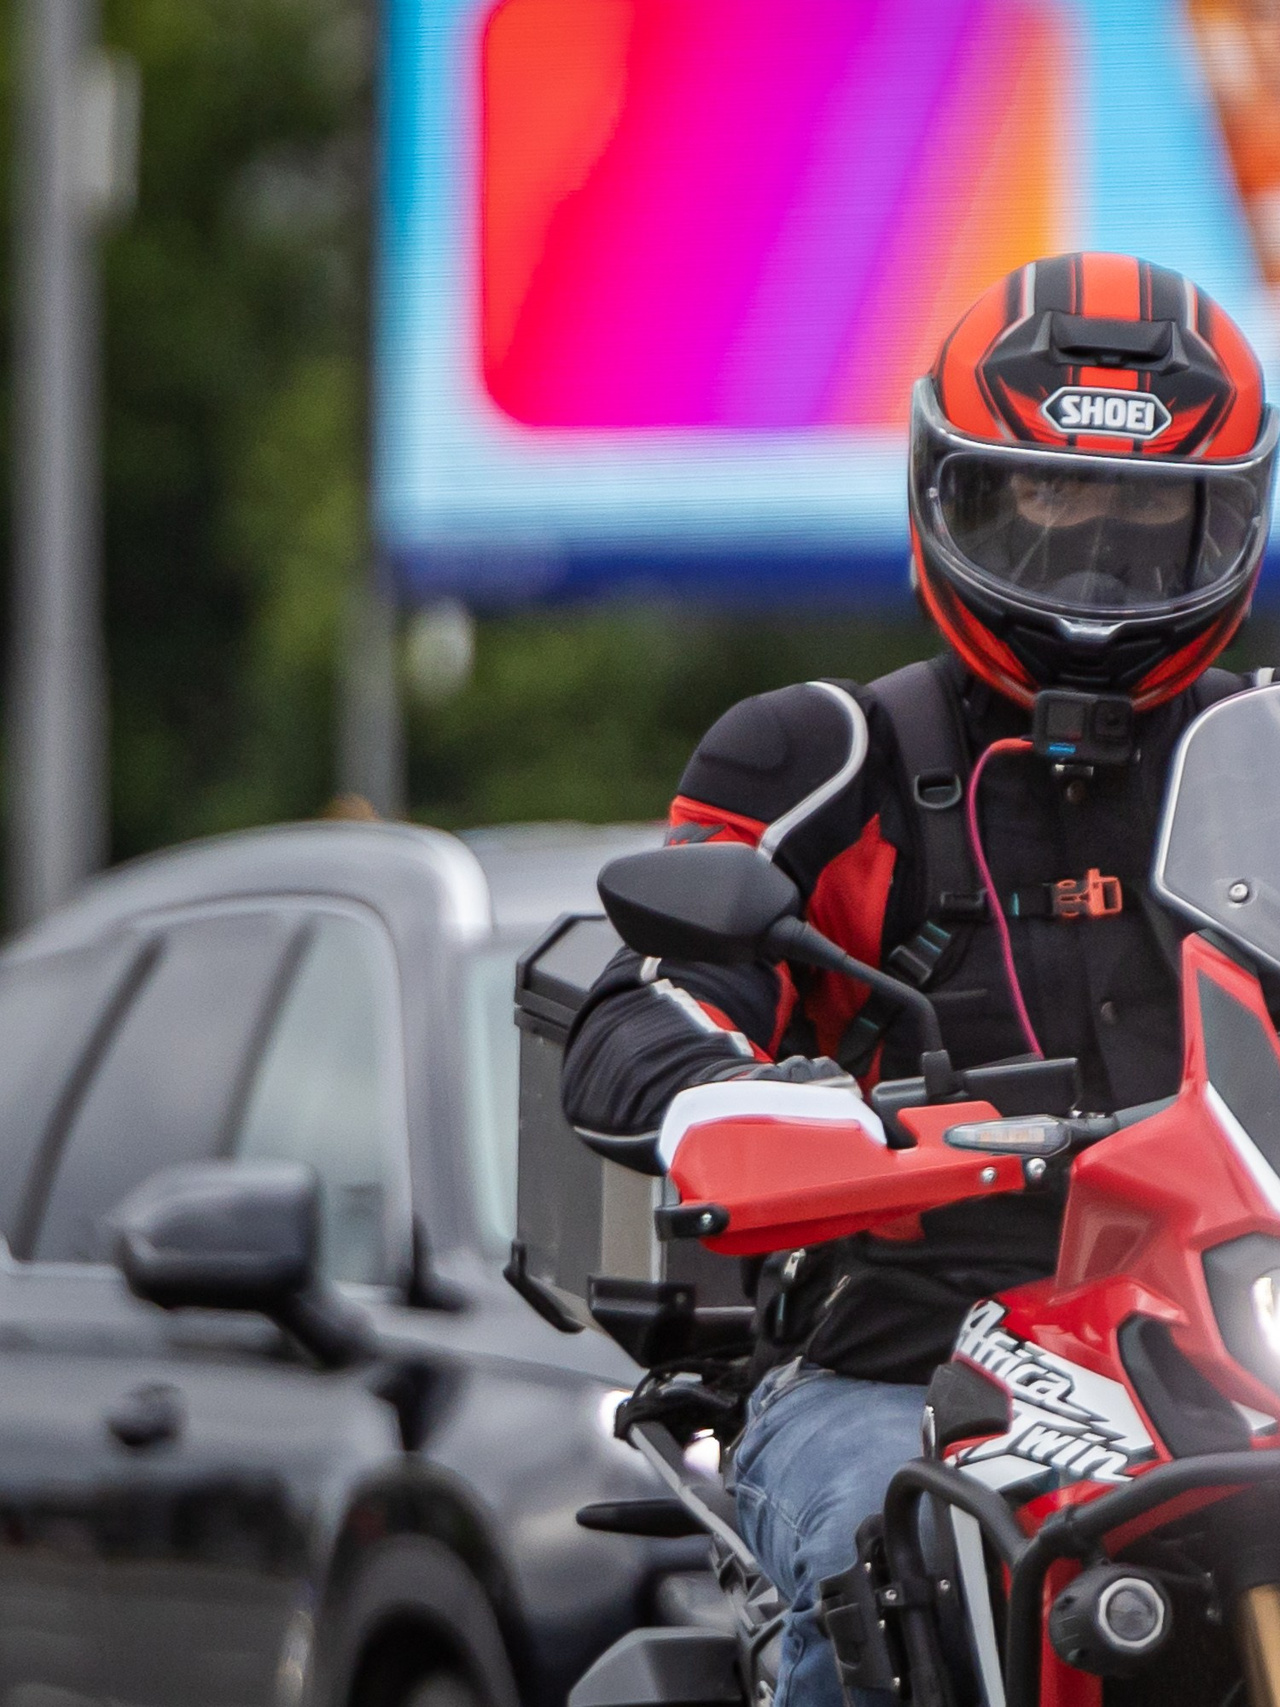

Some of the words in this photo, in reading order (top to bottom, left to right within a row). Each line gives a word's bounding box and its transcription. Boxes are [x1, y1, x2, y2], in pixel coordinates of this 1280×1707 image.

[1061, 395, 1155, 432] SHOEI
[954, 1300, 1092, 1423] Africa
[954, 1404, 1134, 1482] Twin
